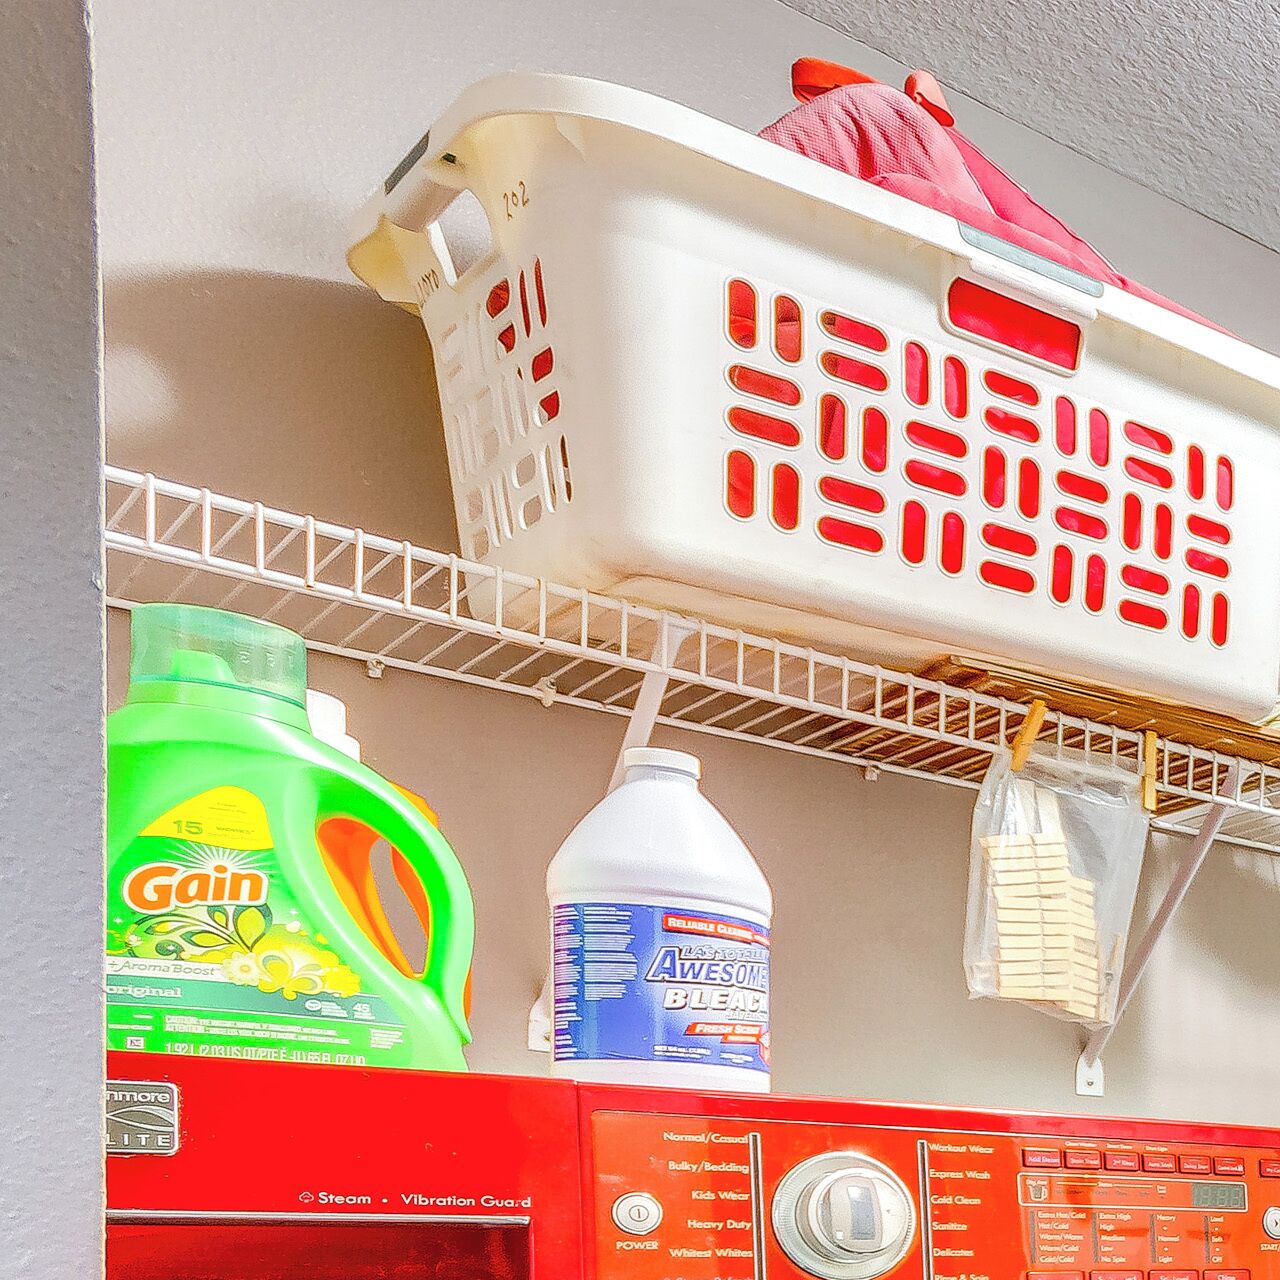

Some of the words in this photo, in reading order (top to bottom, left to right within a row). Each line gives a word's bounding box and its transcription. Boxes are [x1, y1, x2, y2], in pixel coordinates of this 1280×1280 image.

[173, 820, 203, 835] 15
[124, 863, 267, 913] Gain
[668, 917, 715, 932] RELIABLE
[716, 948, 768, 962] TOTALL
[106, 1090, 170, 1103] nmore
[106, 1133, 171, 1147] LITE
[663, 1132, 749, 1144] Normal/Casual
[928, 1143, 967, 1153] Workout
[968, 1145, 995, 1154] Wear
[668, 1160, 750, 1174] Bulky/Bedding
[318, 1192, 372, 1205] Steam
[400, 1194, 476, 1207] Vibration
[691, 1191, 716, 1200] Kids
[718, 1191, 751, 1201] Wear
[687, 1219, 724, 1231] Heavy
[726, 1219, 752, 1231] Duty
[615, 1241, 659, 1250] POWER
[715, 1248, 754, 1258] Whites
